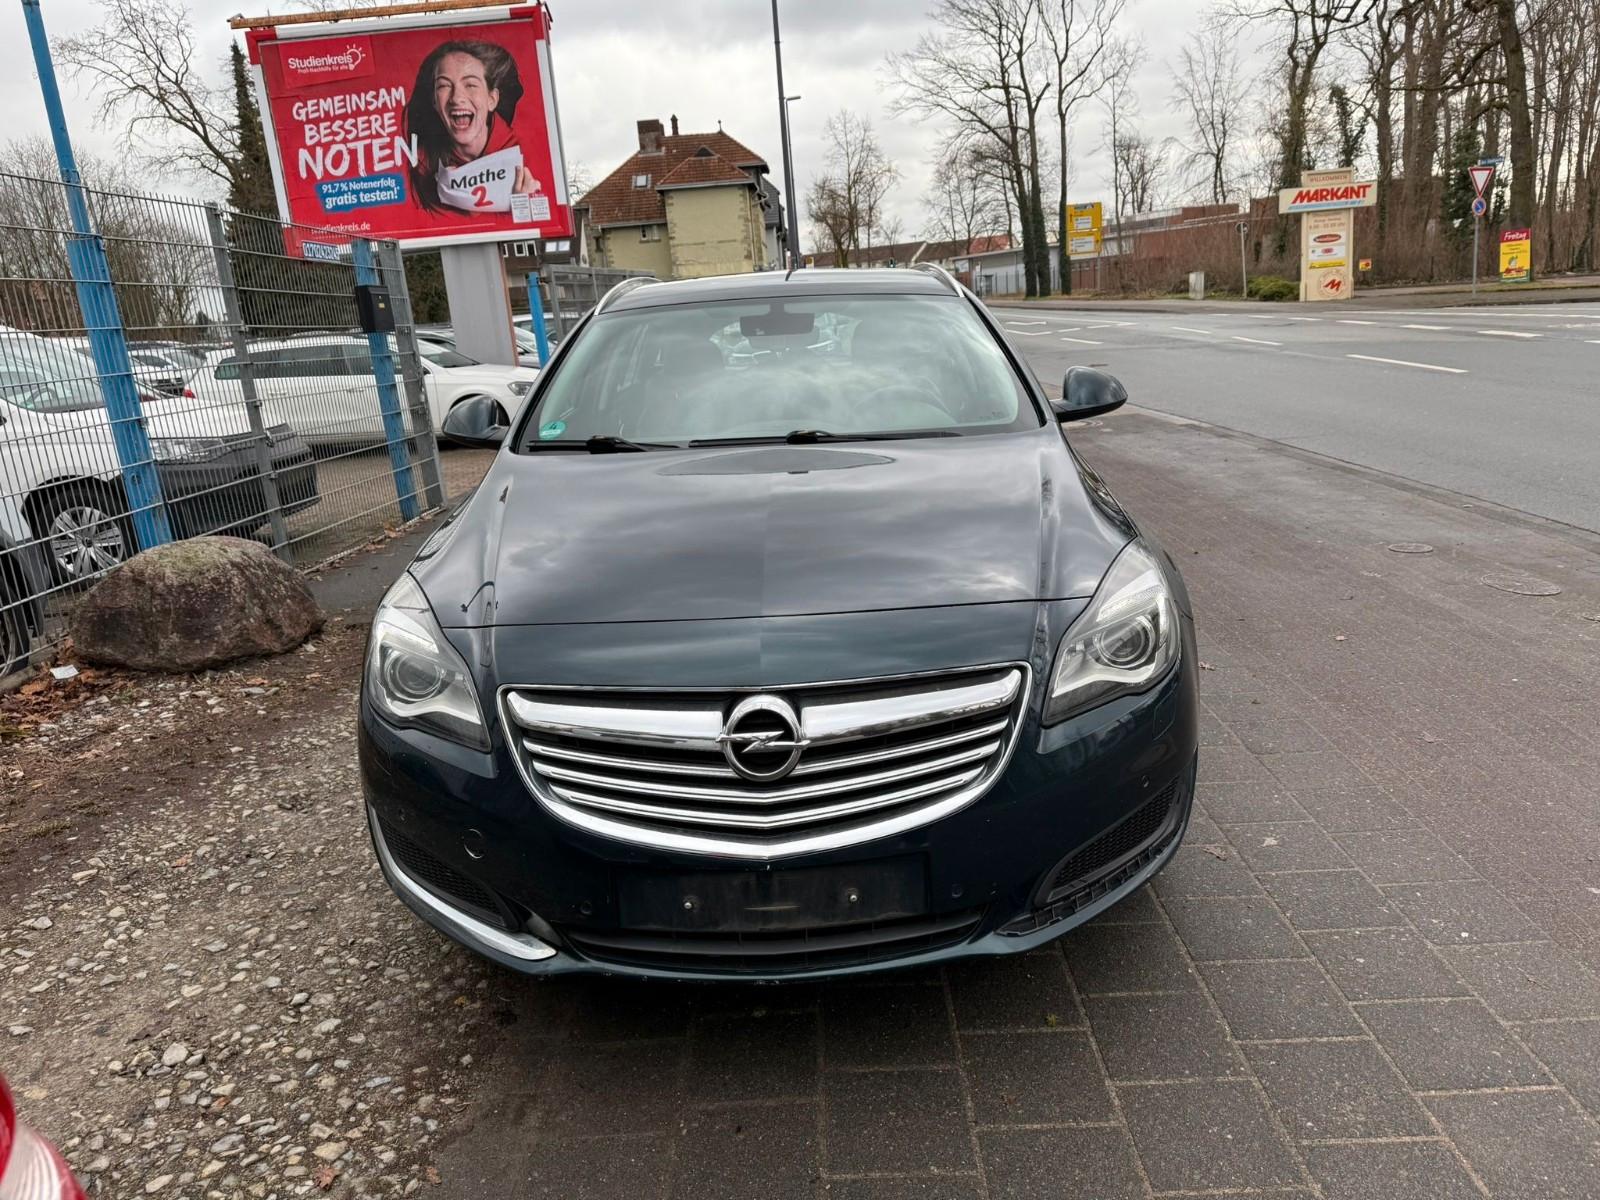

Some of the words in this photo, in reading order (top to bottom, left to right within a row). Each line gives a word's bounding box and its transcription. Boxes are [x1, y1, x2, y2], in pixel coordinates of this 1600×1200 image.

[288, 52, 353, 69] Studienkreis
[292, 86, 406, 121] GEMEINSAM
[304, 112, 398, 146] BESSERE
[298, 133, 418, 180] NOTEN
[322, 183, 340, 194] 91,7
[349, 177, 396, 191] Notenerfolg
[451, 168, 506, 190] Mathe
[325, 191, 358, 209] gratis
[471, 185, 494, 207] 2
[1291, 184, 1372, 204] MARKANT
[1503, 231, 1527, 240] Freitag
